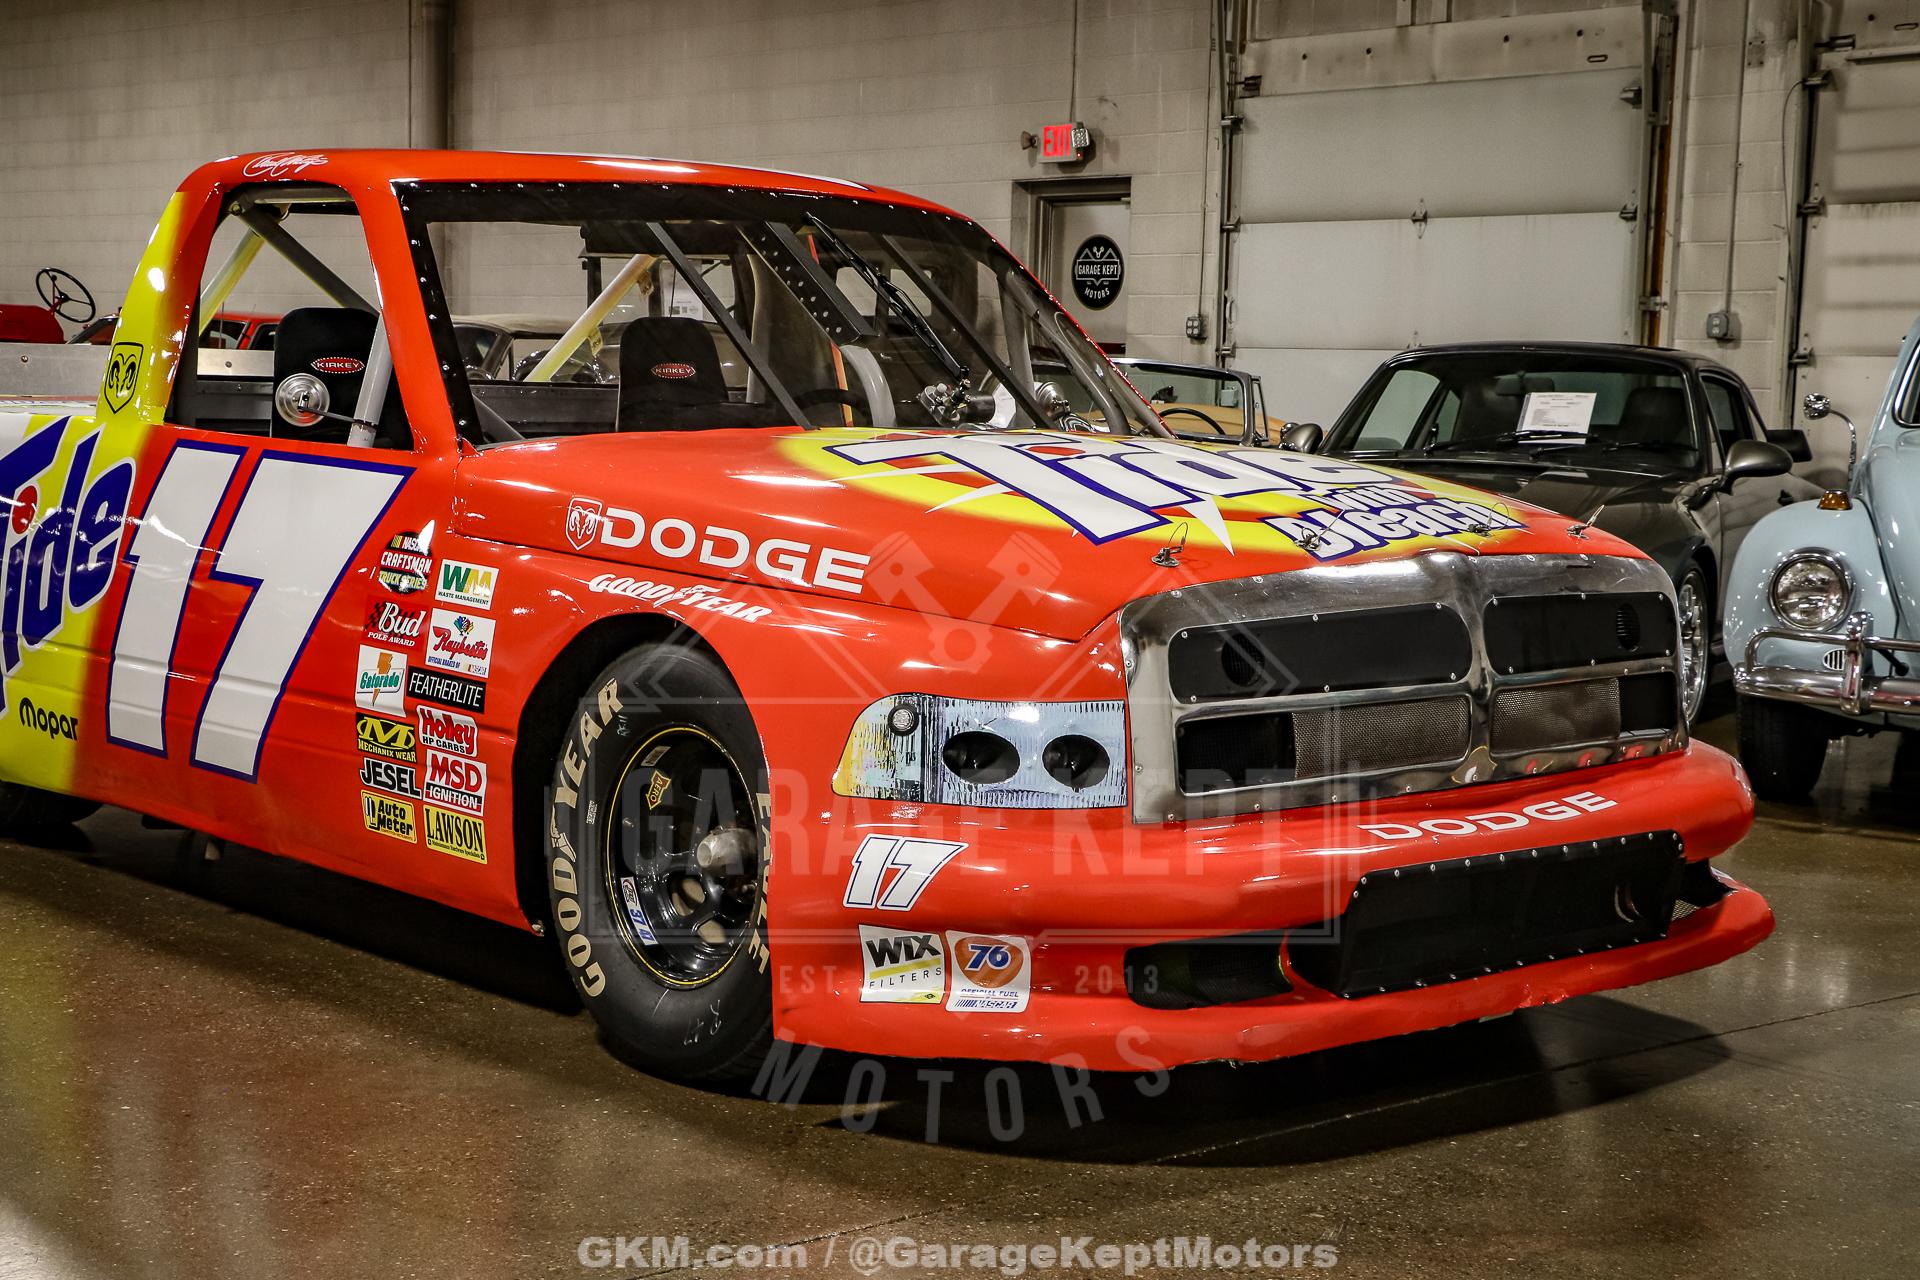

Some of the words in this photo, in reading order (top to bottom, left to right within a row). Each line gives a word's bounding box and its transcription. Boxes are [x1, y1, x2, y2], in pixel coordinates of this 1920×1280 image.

[1043, 123, 1073, 157] EXIT
[1078, 264, 1101, 275] GARAGE
[1102, 264, 1118, 275] KEPT
[1084, 287, 1110, 299] MOTORS
[822, 431, 1412, 546] Tide
[380, 551, 432, 573] CRAFTSMAN
[600, 506, 871, 594] DODGE
[379, 570, 402, 586] TRUCK
[442, 563, 492, 598] WM
[106, 438, 417, 784] 17
[438, 590, 455, 599] WASTE
[454, 593, 489, 605] MANAGEMENT
[588, 573, 772, 623] GOODYEAR
[378, 602, 427, 637] Bud
[367, 631, 390, 641] POLE
[390, 636, 416, 648] AWARD
[360, 671, 400, 690] Gatorade
[408, 671, 484, 708] FEATHERLITE
[420, 708, 475, 754] Holley
[422, 735, 434, 746] HP
[435, 738, 466, 754] CARBS
[357, 737, 395, 758] MECHANIX
[394, 748, 417, 763] WEAR
[361, 760, 422, 798] JESEL
[429, 752, 483, 794] MSD
[649, 776, 664, 802] AERO
[378, 799, 406, 821] Auto
[429, 784, 478, 809] IGNITION
[378, 813, 413, 836] Meter
[425, 808, 484, 853] LAWSON
[1356, 791, 1617, 840] DODGE
[549, 678, 624, 998] GOODYEAR
[843, 833, 969, 911] 17
[866, 935, 941, 968] WIX
[965, 944, 1012, 971] 76
[869, 968, 942, 990] FILTERS
